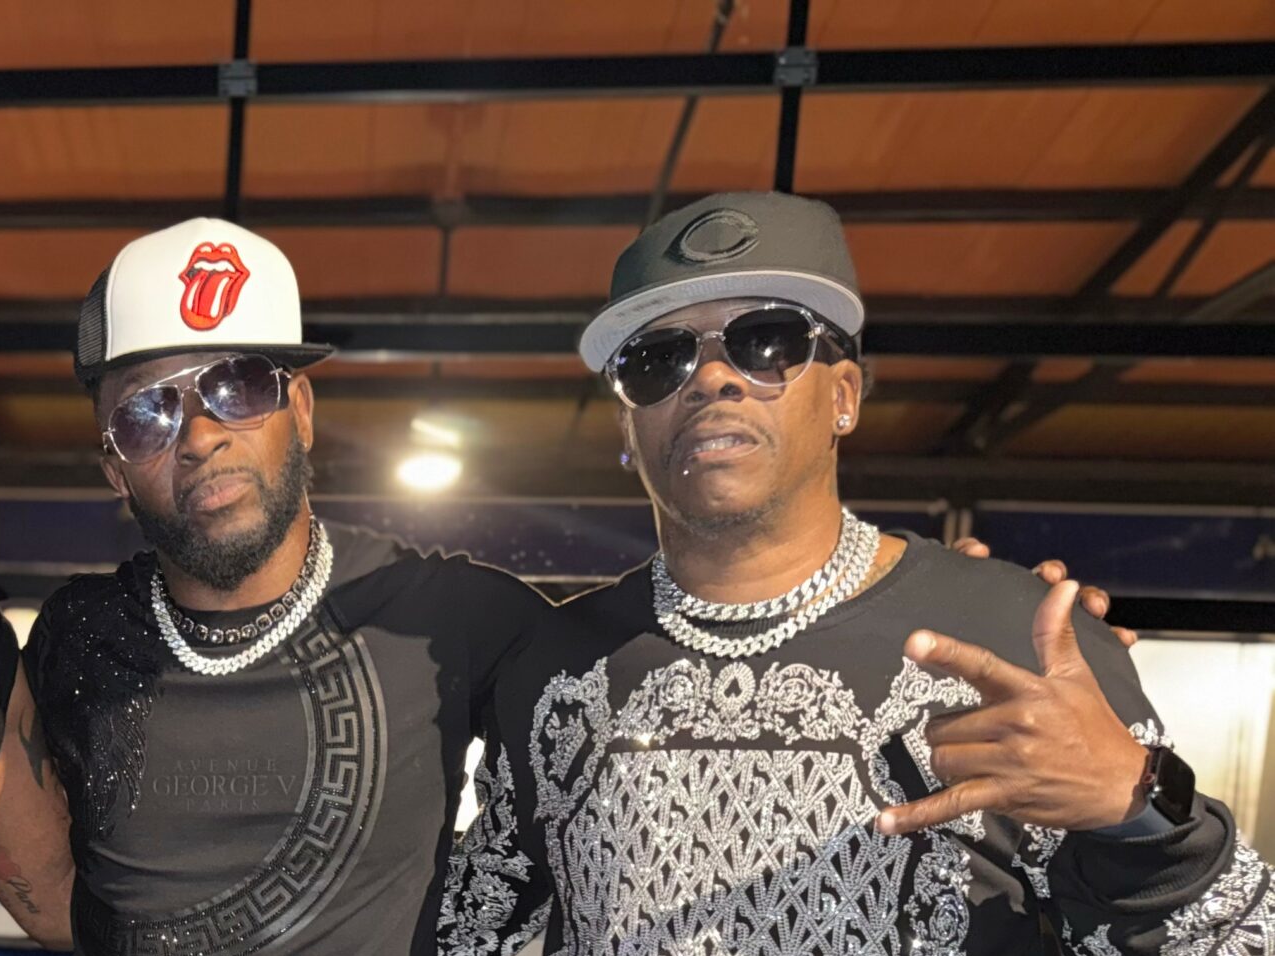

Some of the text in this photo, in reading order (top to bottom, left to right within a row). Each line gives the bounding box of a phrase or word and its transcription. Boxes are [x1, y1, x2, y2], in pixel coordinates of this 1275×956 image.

[175, 759, 277, 773] AVENUE
[153, 774, 297, 797] GEORGE V
[186, 798, 261, 812] PARIS
